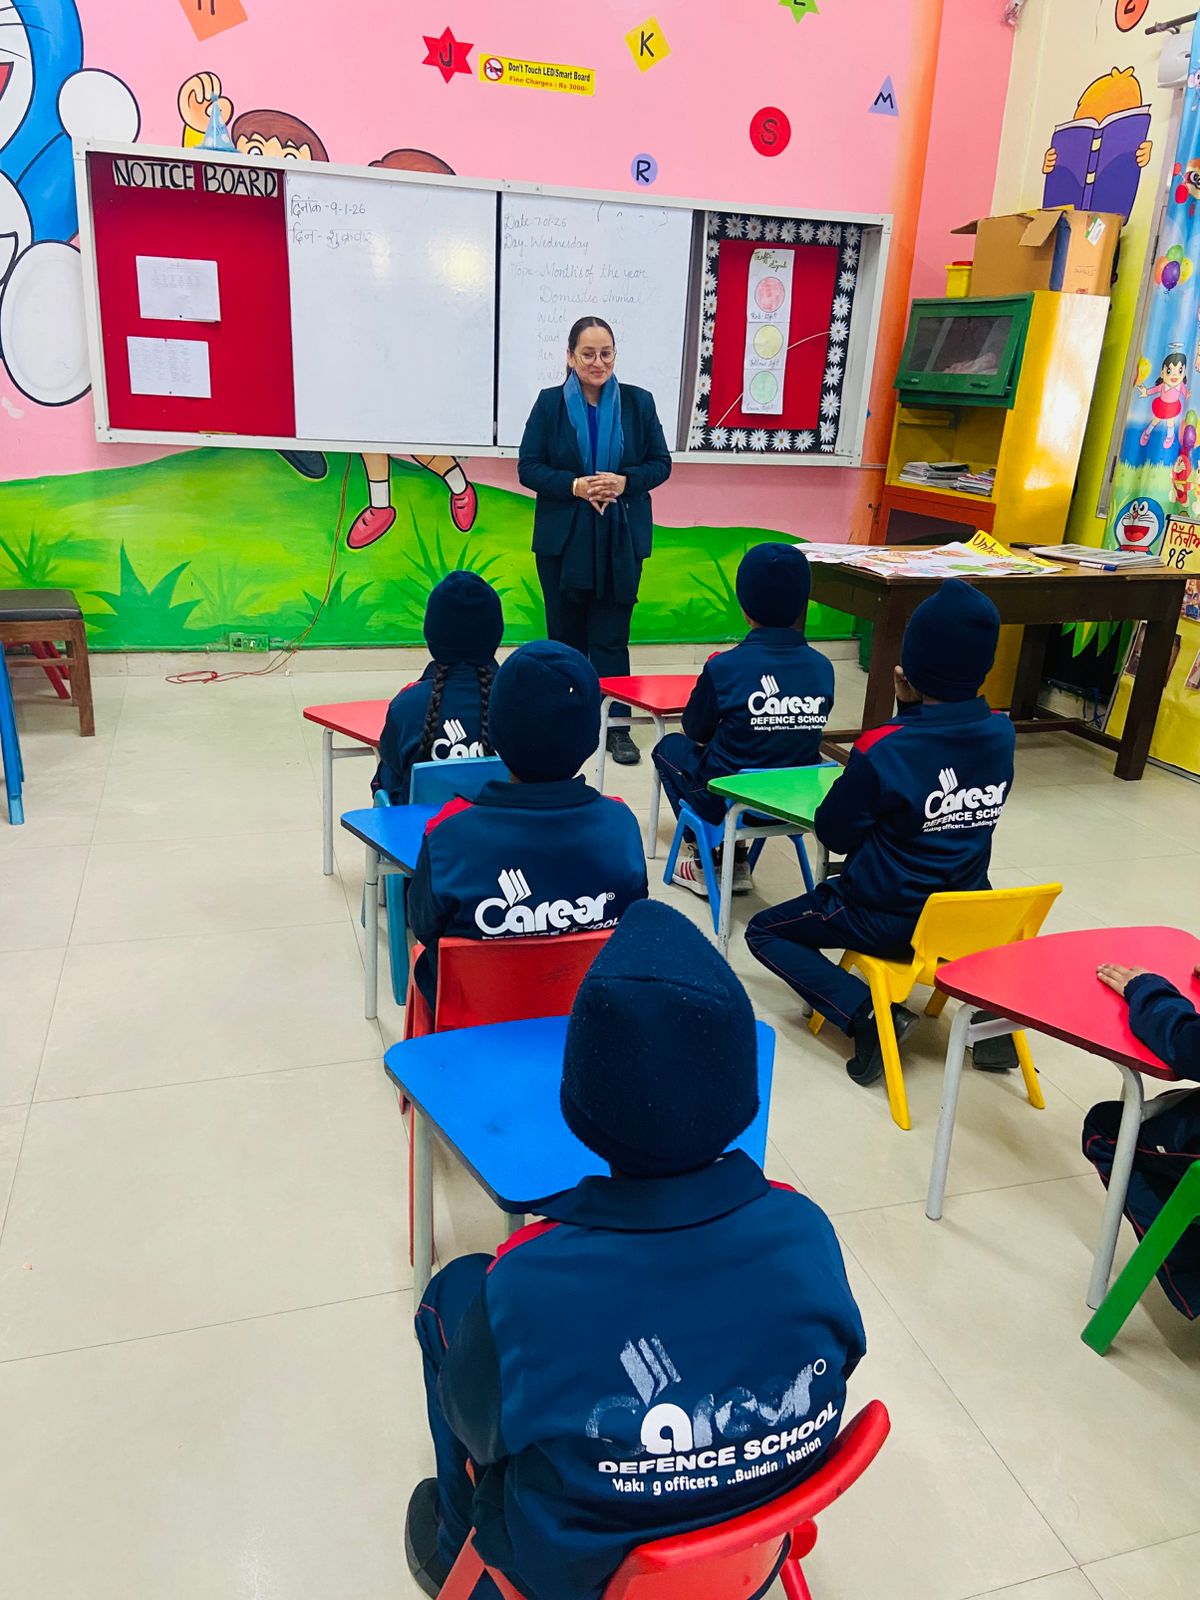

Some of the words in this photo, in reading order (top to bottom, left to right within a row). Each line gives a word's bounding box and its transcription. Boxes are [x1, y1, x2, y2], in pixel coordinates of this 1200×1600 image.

[439, 43, 453, 67] J
[640, 31, 655, 57] K
[508, 62, 523, 72] Don't
[525, 64, 541, 75] Touch
[573, 71, 591, 82] Board
[509, 75, 524, 83] Fine
[525, 78, 553, 88] Charges
[874, 91, 894, 109] M
[760, 118, 778, 146] S
[113, 159, 194, 190] NOTICE
[204, 163, 277, 197] BOARD
[636, 160, 651, 183] R
[600, 264, 620, 279] the
[750, 715, 796, 725] DEFENCE
[922, 811, 973, 829] DEFENCE
[598, 1445, 736, 1475] DEFENCE
[743, 1401, 838, 1461] SCHOOL
[664, 1475, 719, 1492] officers
[785, 1437, 822, 1466] Nation
